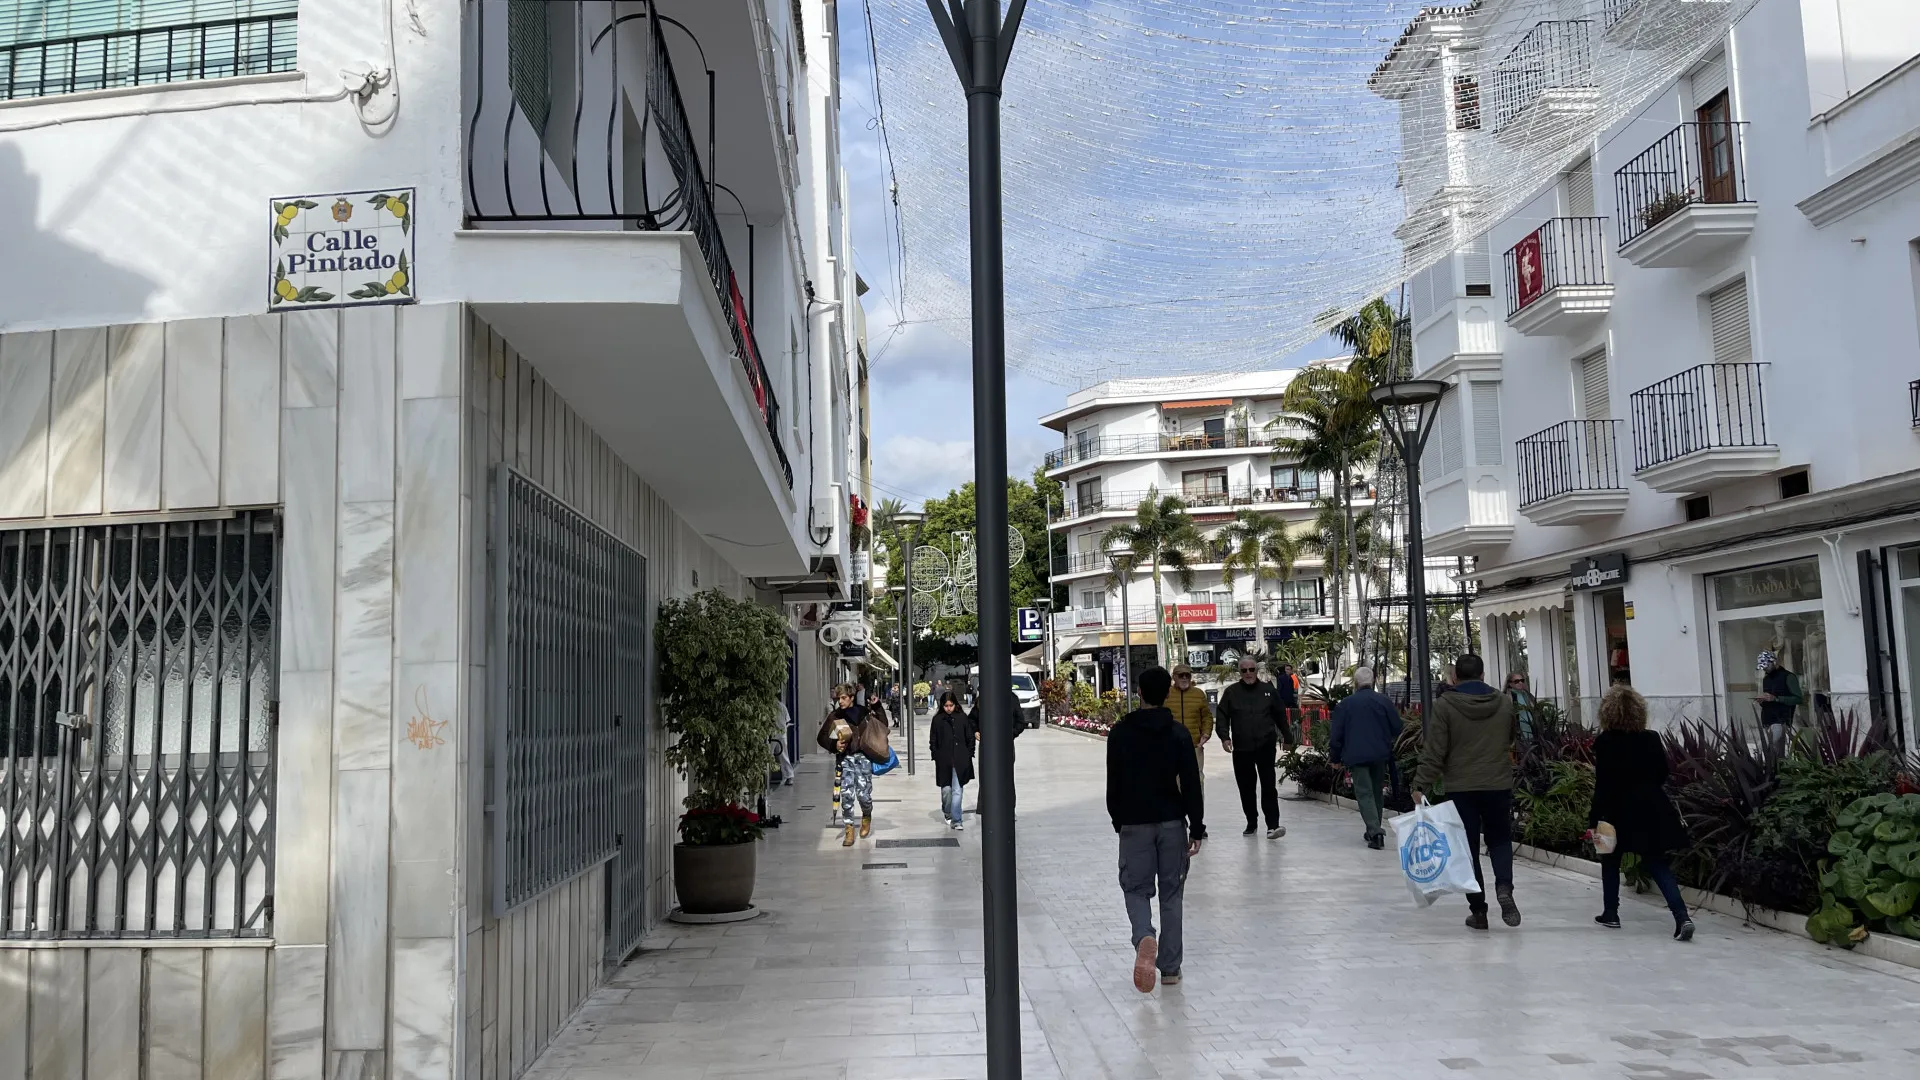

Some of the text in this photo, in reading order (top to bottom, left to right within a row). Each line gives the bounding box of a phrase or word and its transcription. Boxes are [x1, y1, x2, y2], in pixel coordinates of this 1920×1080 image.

[307, 230, 377, 252] Calle
[287, 250, 395, 274] Pintado
[1747, 578, 1802, 596] DANDARA
[1025, 610, 1039, 628] P
[1178, 609, 1214, 617] GENERALI
[1225, 629, 1247, 638] MAGIC
[1248, 628, 1281, 637] SCSORS
